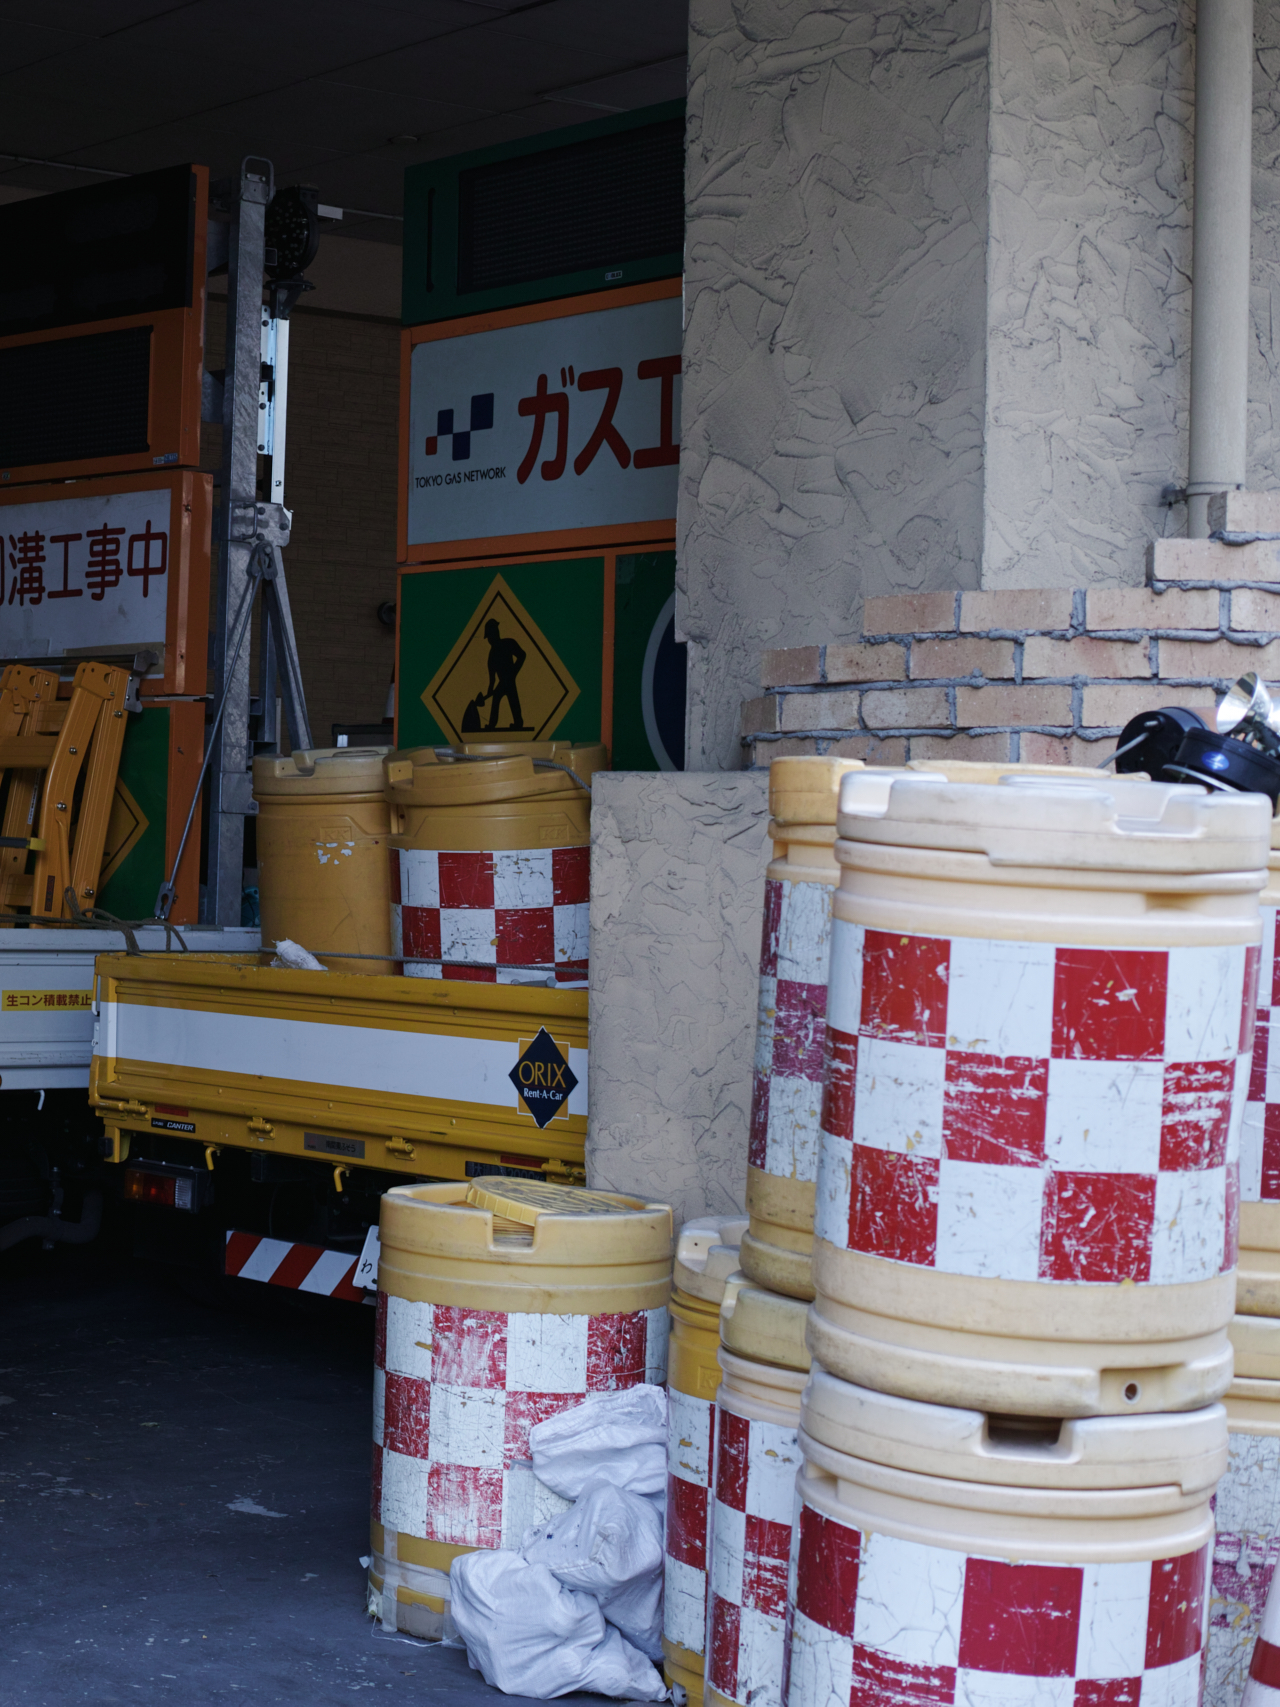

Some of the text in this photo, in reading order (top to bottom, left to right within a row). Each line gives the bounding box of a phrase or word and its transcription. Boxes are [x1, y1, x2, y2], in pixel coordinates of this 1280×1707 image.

[415, 466, 506, 488] TOKYO GAS NETWORK
[6, 993, 92, 1007] 生コン積載禁止
[518, 1060, 567, 1088] ORIX
[523, 1087, 564, 1101] Rent-A-Car
[166, 1121, 194, 1132] CANTER
